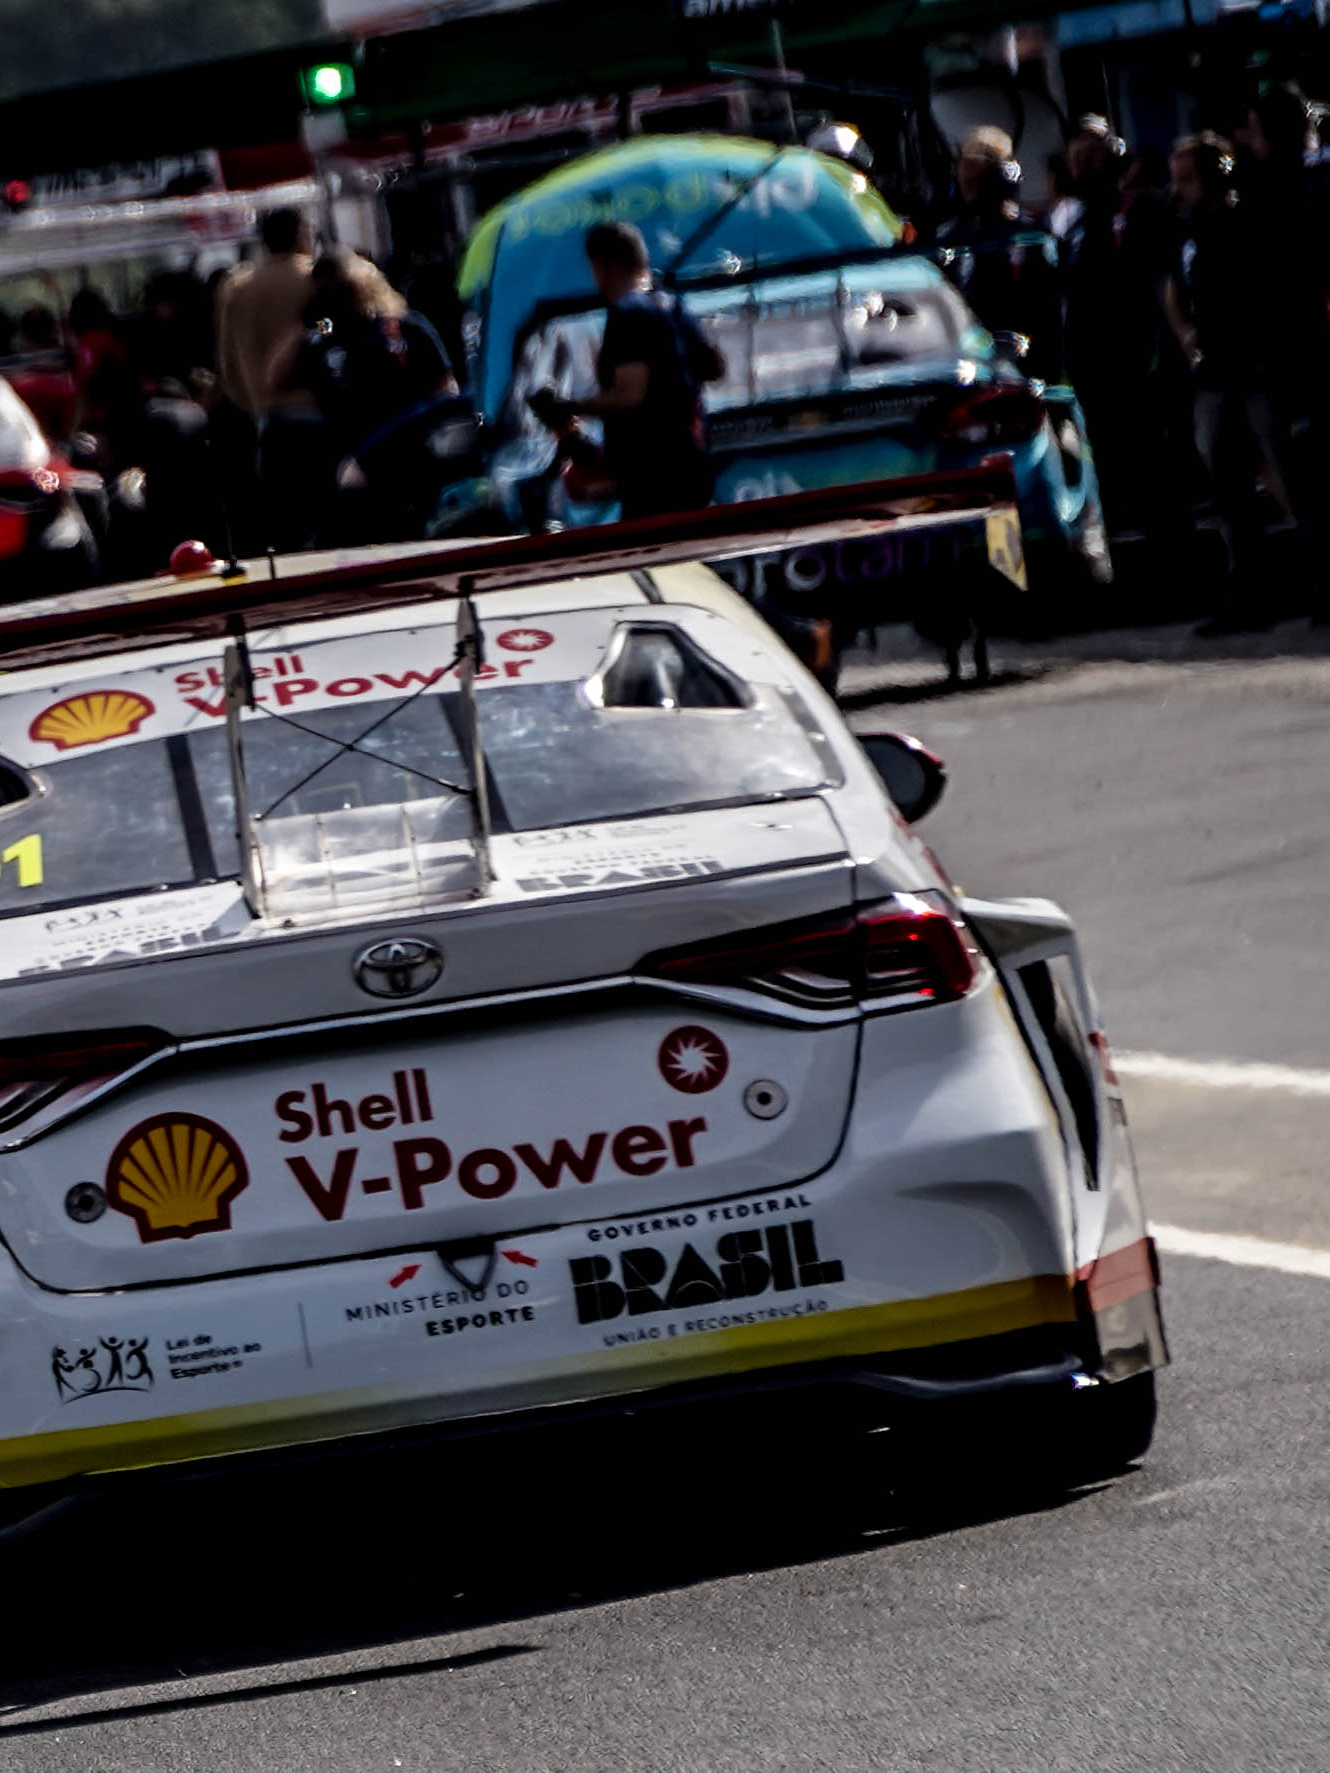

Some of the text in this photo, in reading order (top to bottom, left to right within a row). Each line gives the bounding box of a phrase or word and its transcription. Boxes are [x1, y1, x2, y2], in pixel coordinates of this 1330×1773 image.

[275, 1068, 434, 1143] Shell
[285, 1116, 708, 1222] V-Power
[587, 1194, 812, 1242] GOVERNO FEDERAL
[569, 1219, 845, 1325] BRASIL
[345, 1279, 530, 1322] MINISTÉRIO DO
[424, 1305, 536, 1337] ESPORTE
[603, 1299, 829, 1347] UNIÃO E RECONSTRUÇÃO
